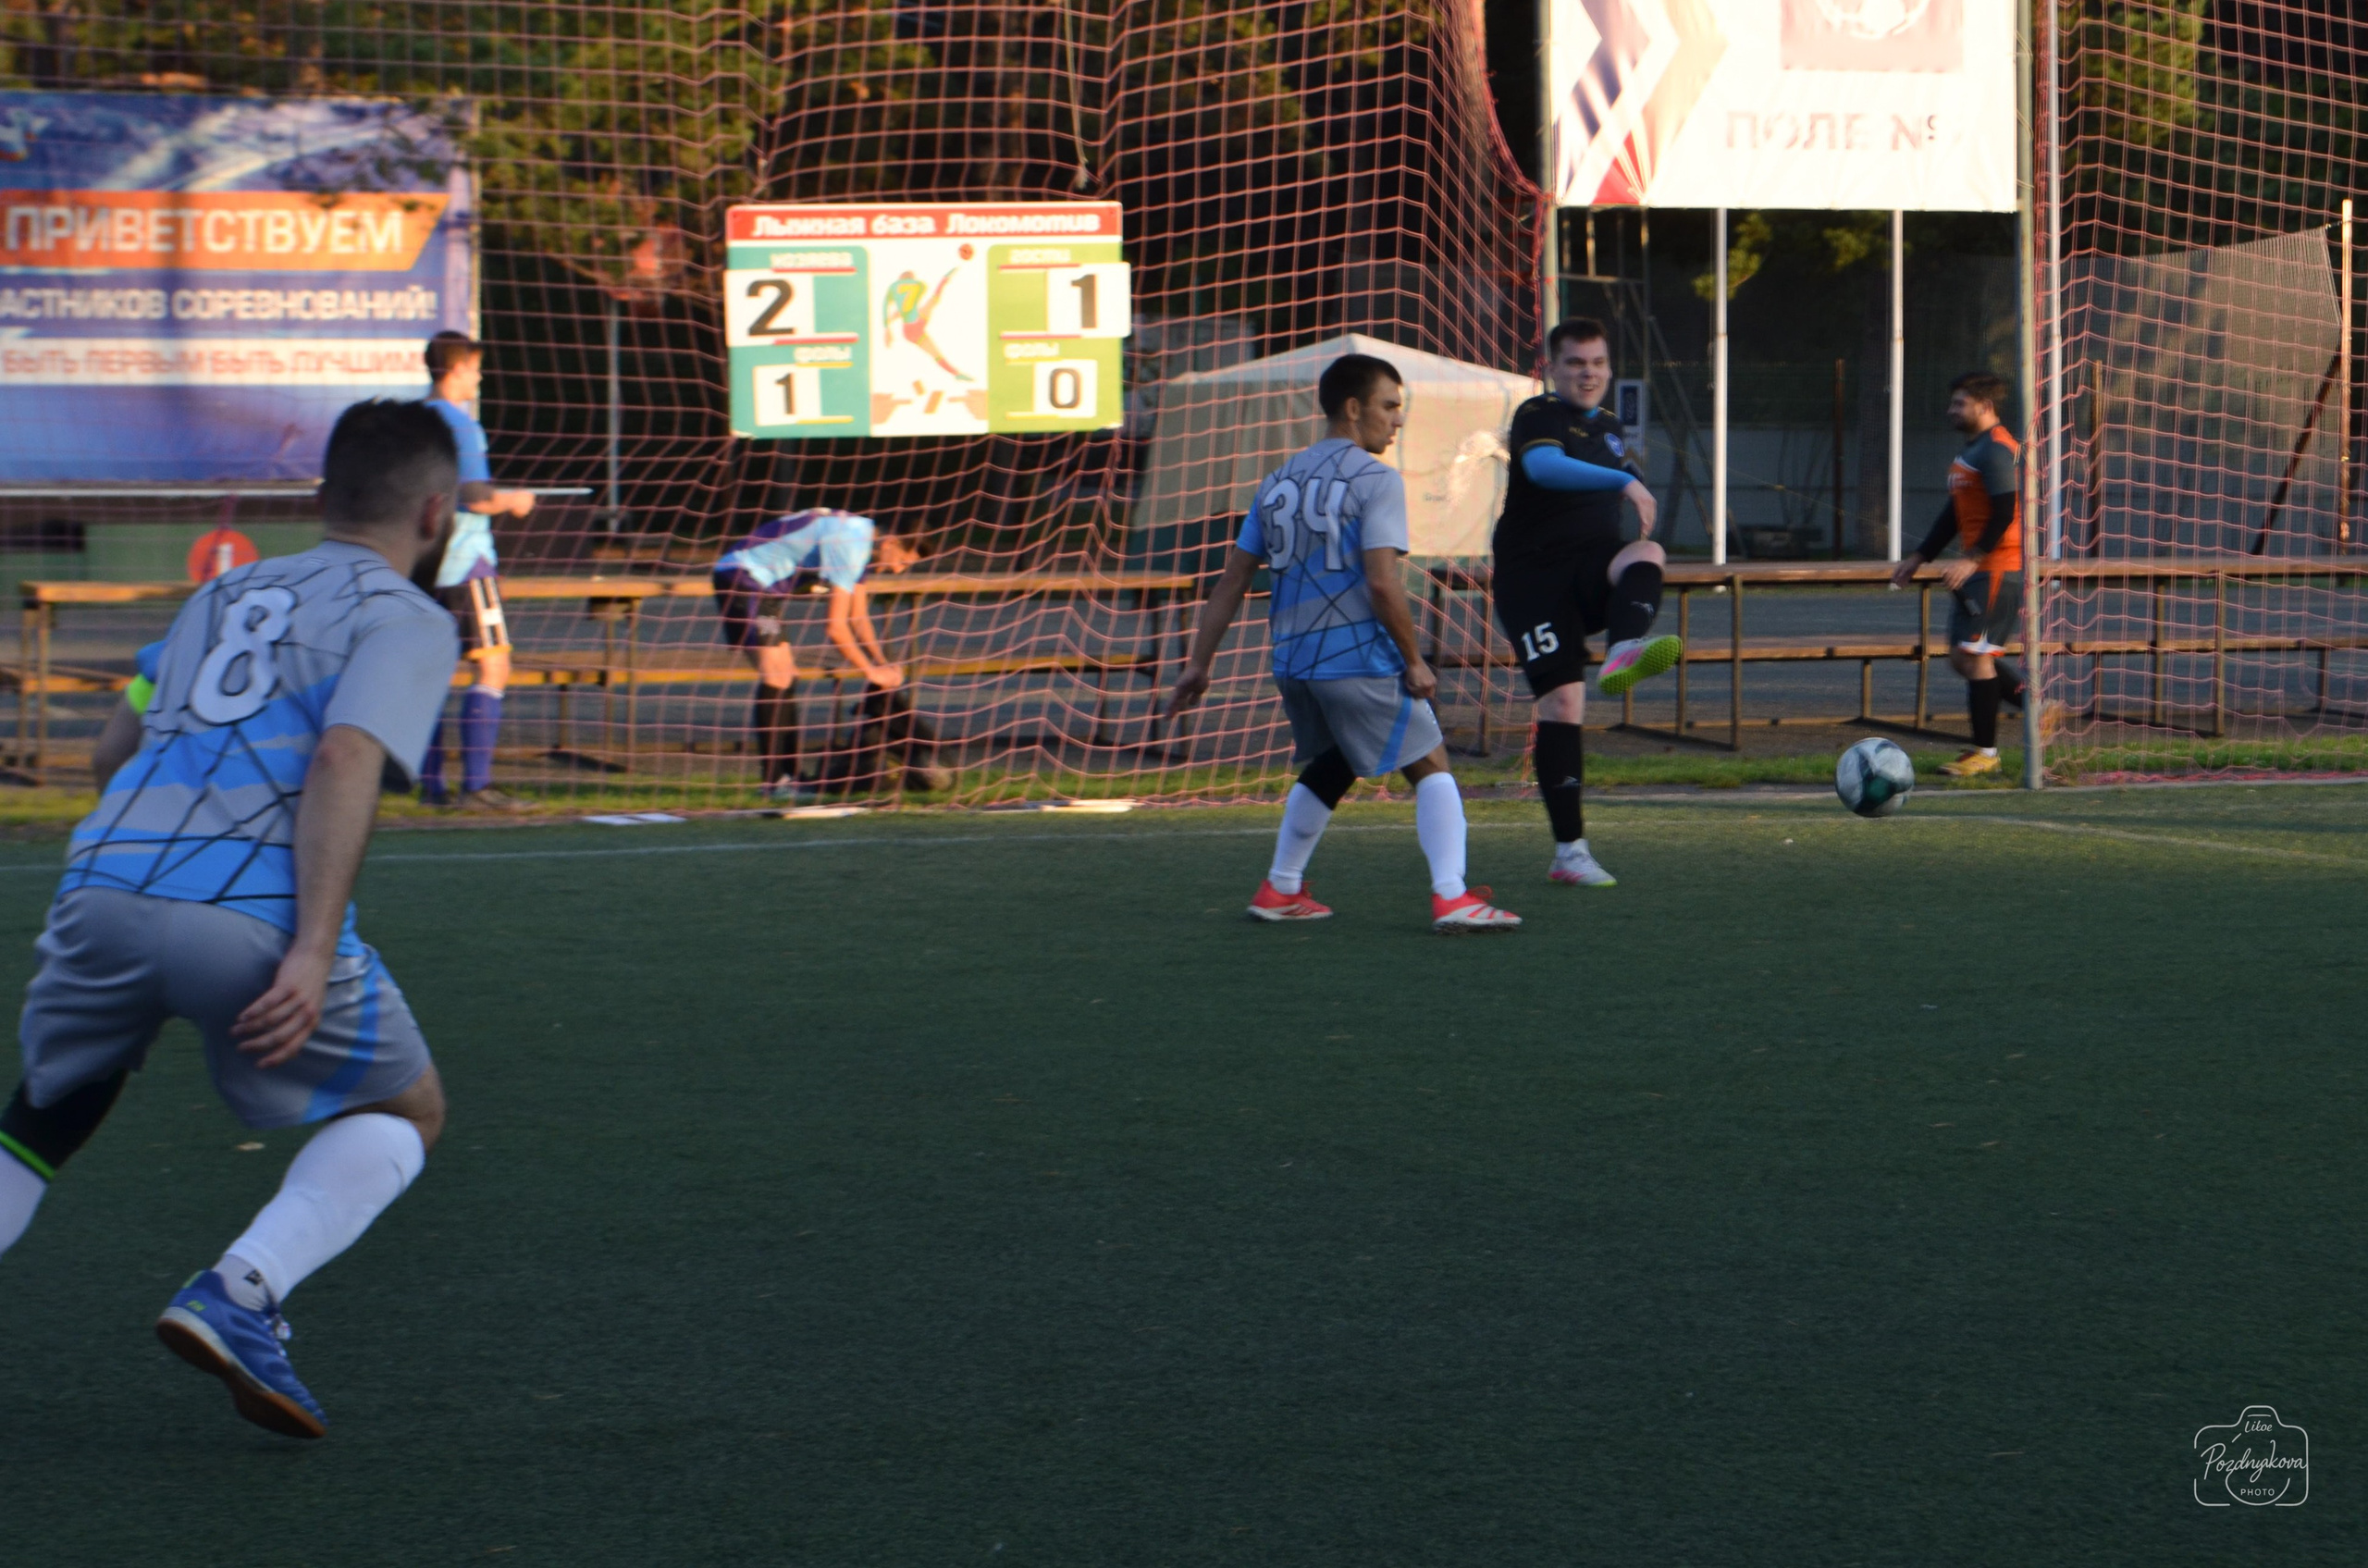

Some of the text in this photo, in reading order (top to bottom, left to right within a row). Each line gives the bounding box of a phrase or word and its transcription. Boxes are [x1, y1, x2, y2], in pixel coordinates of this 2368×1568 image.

[1726, 111, 1868, 150] ПОЛЕ
[6, 205, 404, 254] ПРИВЕТСТВУЕМ
[751, 213, 1102, 238] Лыжная база Локомотив
[746, 278, 796, 337] 2
[1070, 273, 1099, 329] 1
[775, 373, 796, 415] 1
[1049, 367, 1081, 409] 0
[1262, 476, 1349, 572] 34
[191, 585, 298, 725] 8
[1521, 622, 1560, 661] 15
